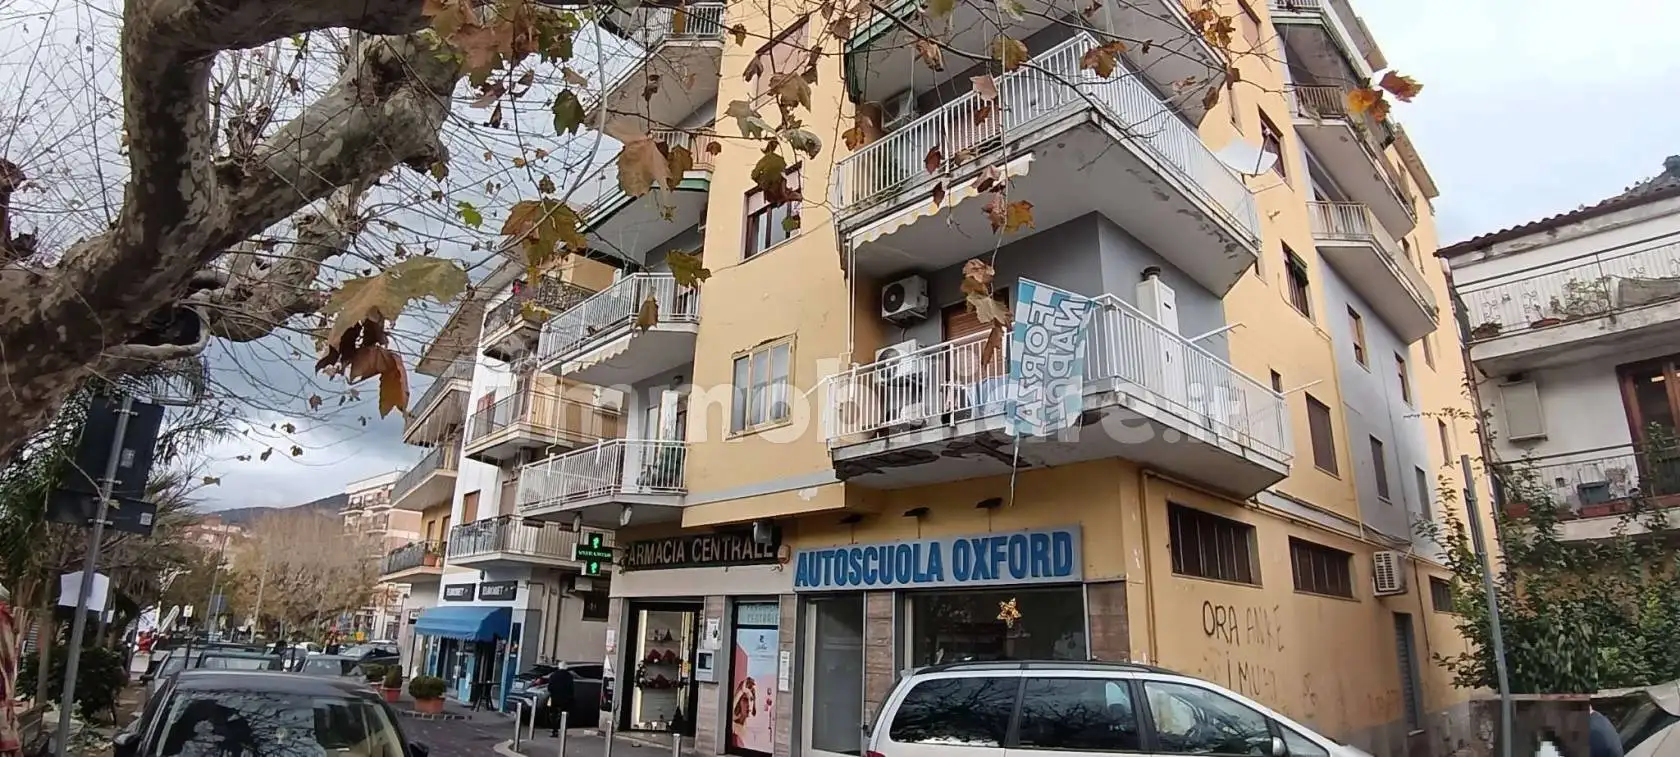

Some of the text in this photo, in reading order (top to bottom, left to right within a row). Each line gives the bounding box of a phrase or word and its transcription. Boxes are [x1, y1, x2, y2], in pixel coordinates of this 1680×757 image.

[794, 531, 1073, 587] AUTOSCUOLA OXFORD
[1202, 600, 1240, 647] ORA
